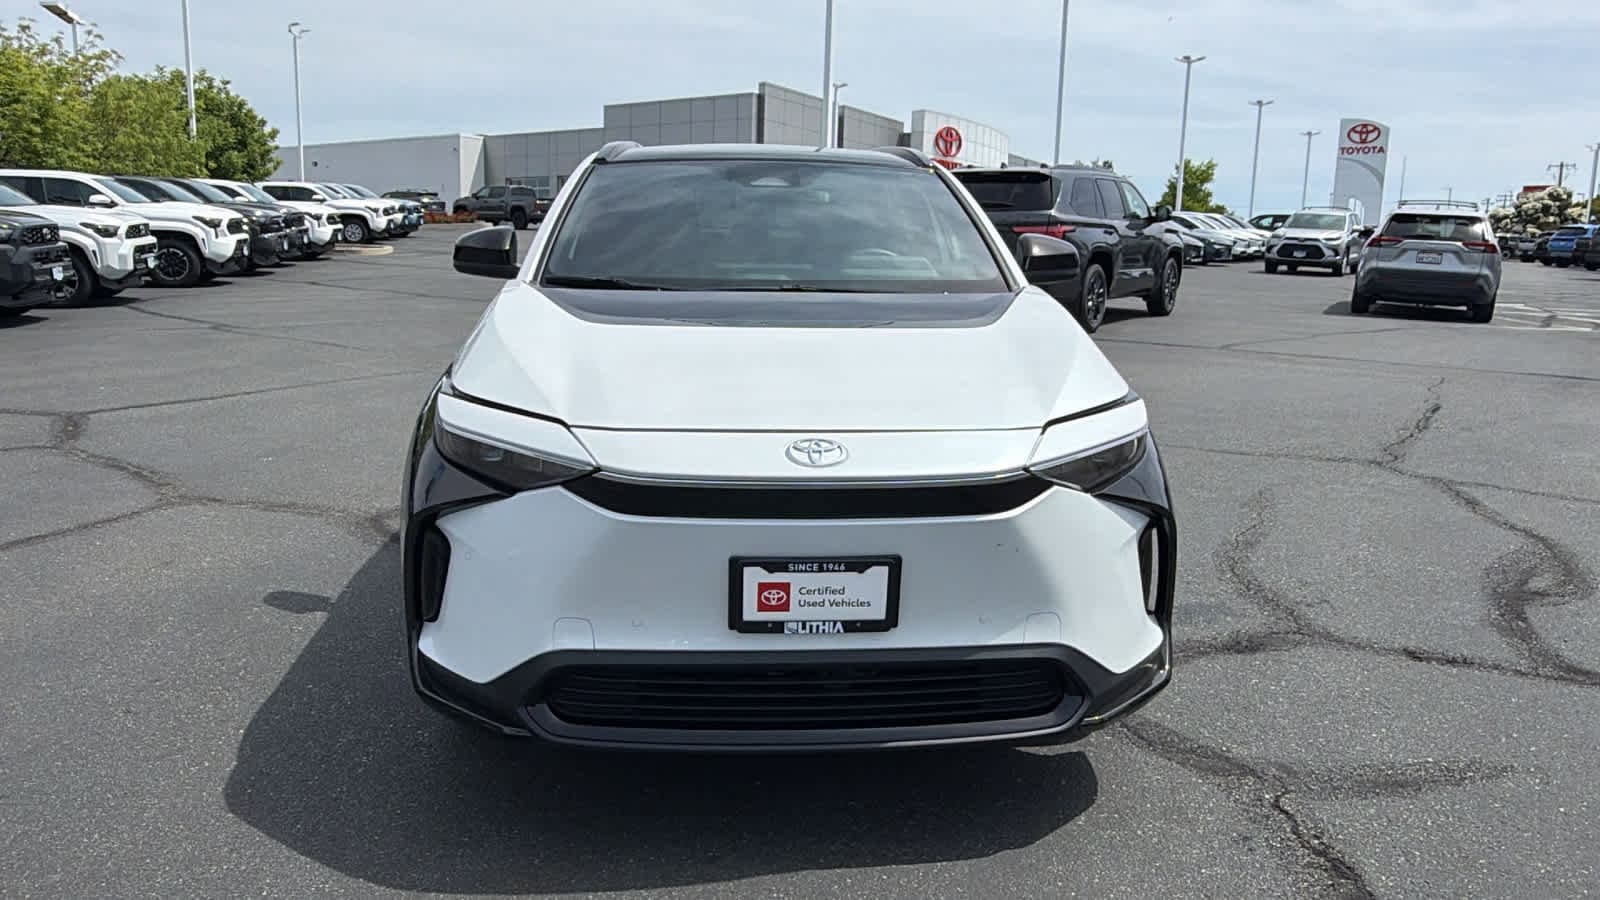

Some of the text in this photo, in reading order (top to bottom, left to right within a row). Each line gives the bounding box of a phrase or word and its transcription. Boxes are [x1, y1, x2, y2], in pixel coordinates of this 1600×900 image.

[1340, 146, 1385, 155] TOYOTA
[788, 563, 846, 571] SINCE 1946
[798, 586, 845, 596] Certified
[798, 599, 871, 608] Used Vehicles
[797, 621, 845, 634] LITHIA
